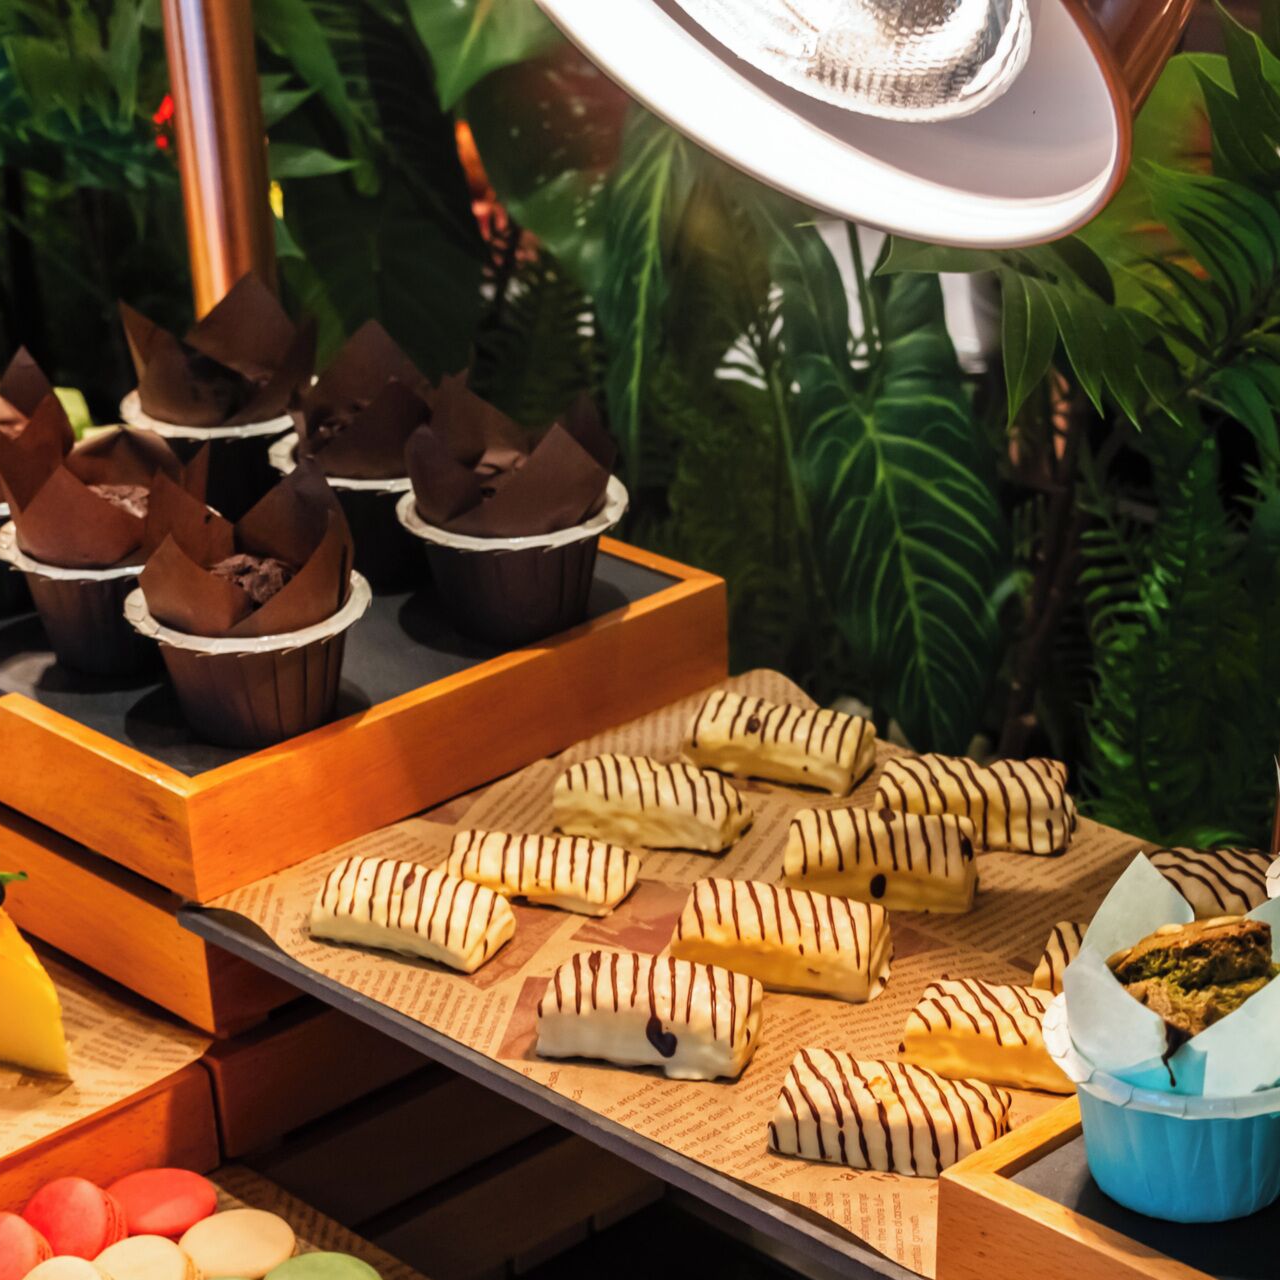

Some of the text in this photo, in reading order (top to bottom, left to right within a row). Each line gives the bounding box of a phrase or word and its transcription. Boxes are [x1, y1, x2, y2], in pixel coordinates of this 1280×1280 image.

[615, 1082, 654, 1108] around
[660, 1079, 688, 1099] from
[654, 1087, 703, 1118] historical
[649, 1094, 718, 1139] process and
[675, 1117, 707, 1140] bread
[705, 1102, 734, 1124] daily
[710, 1140, 724, 1154] in
[876, 1208, 885, 1225] more
[877, 1227, 886, 1240] the
[894, 1228, 904, 1260] welcome
